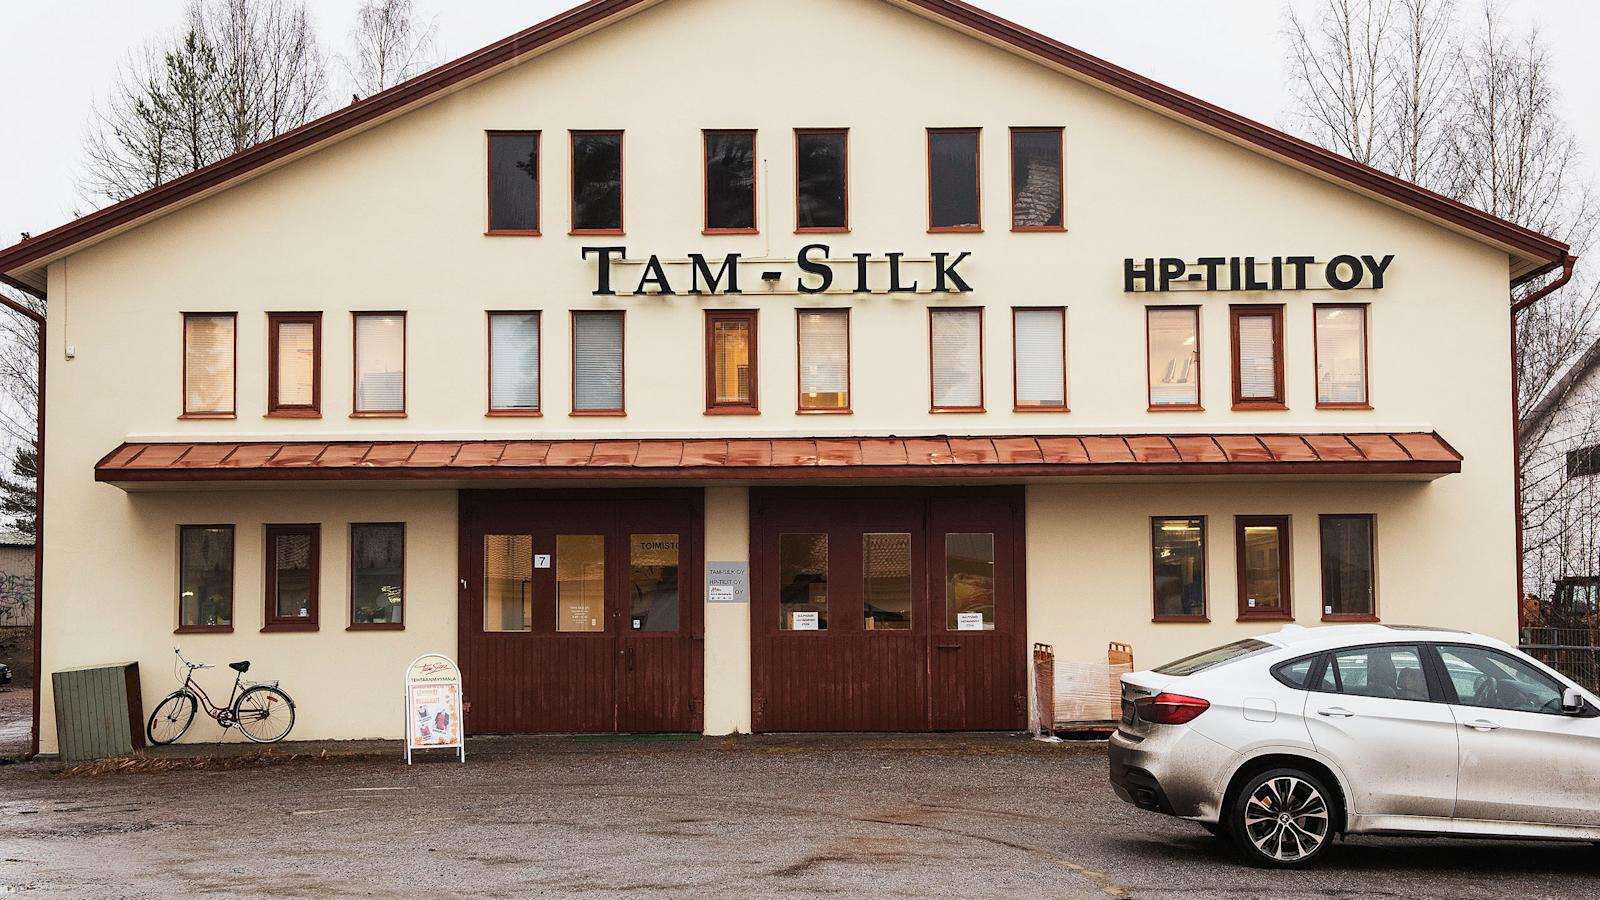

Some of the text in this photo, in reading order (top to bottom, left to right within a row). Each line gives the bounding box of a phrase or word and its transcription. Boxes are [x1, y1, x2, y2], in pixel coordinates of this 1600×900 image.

[1124, 254, 1395, 292] HP-TILIT OY
[539, 556, 546, 566] 7
